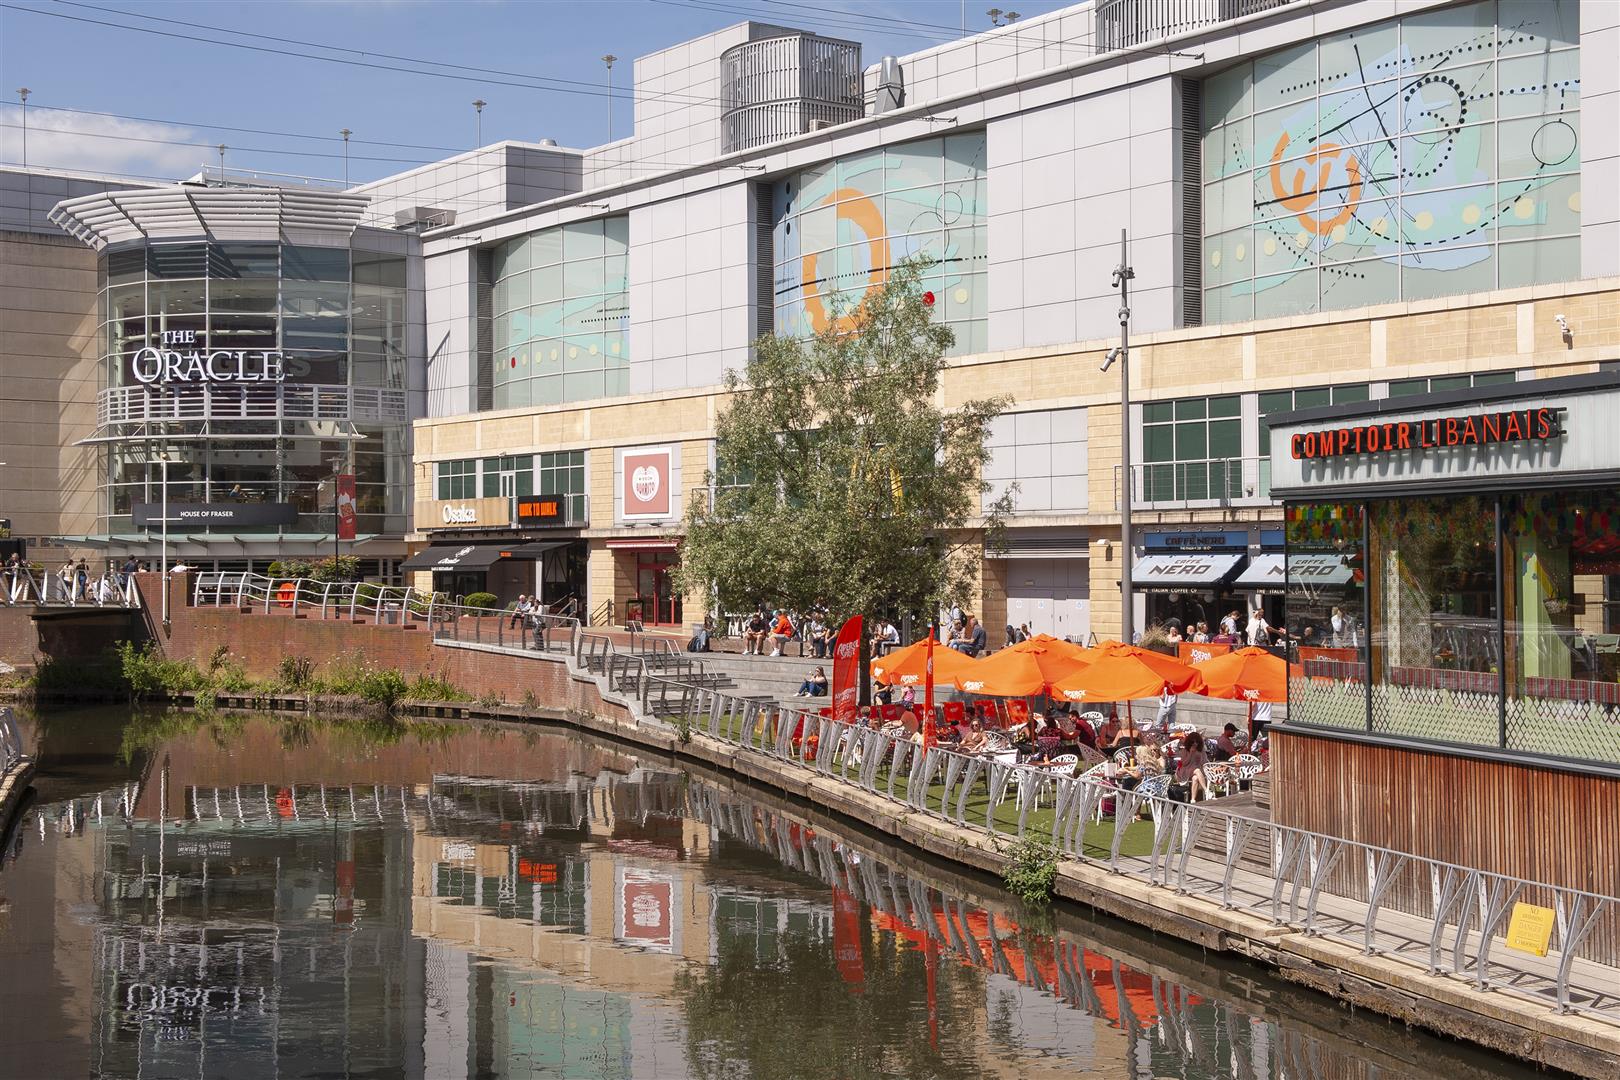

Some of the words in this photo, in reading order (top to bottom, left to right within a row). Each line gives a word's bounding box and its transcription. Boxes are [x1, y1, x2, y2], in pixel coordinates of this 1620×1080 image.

[161, 330, 195, 343] THE
[132, 347, 285, 382] ORACLE
[1292, 423, 1410, 459] COMPTOIR
[1421, 408, 1549, 448] LIBANAIS
[443, 504, 477, 523] Osaka
[1149, 565, 1211, 575] NERO
